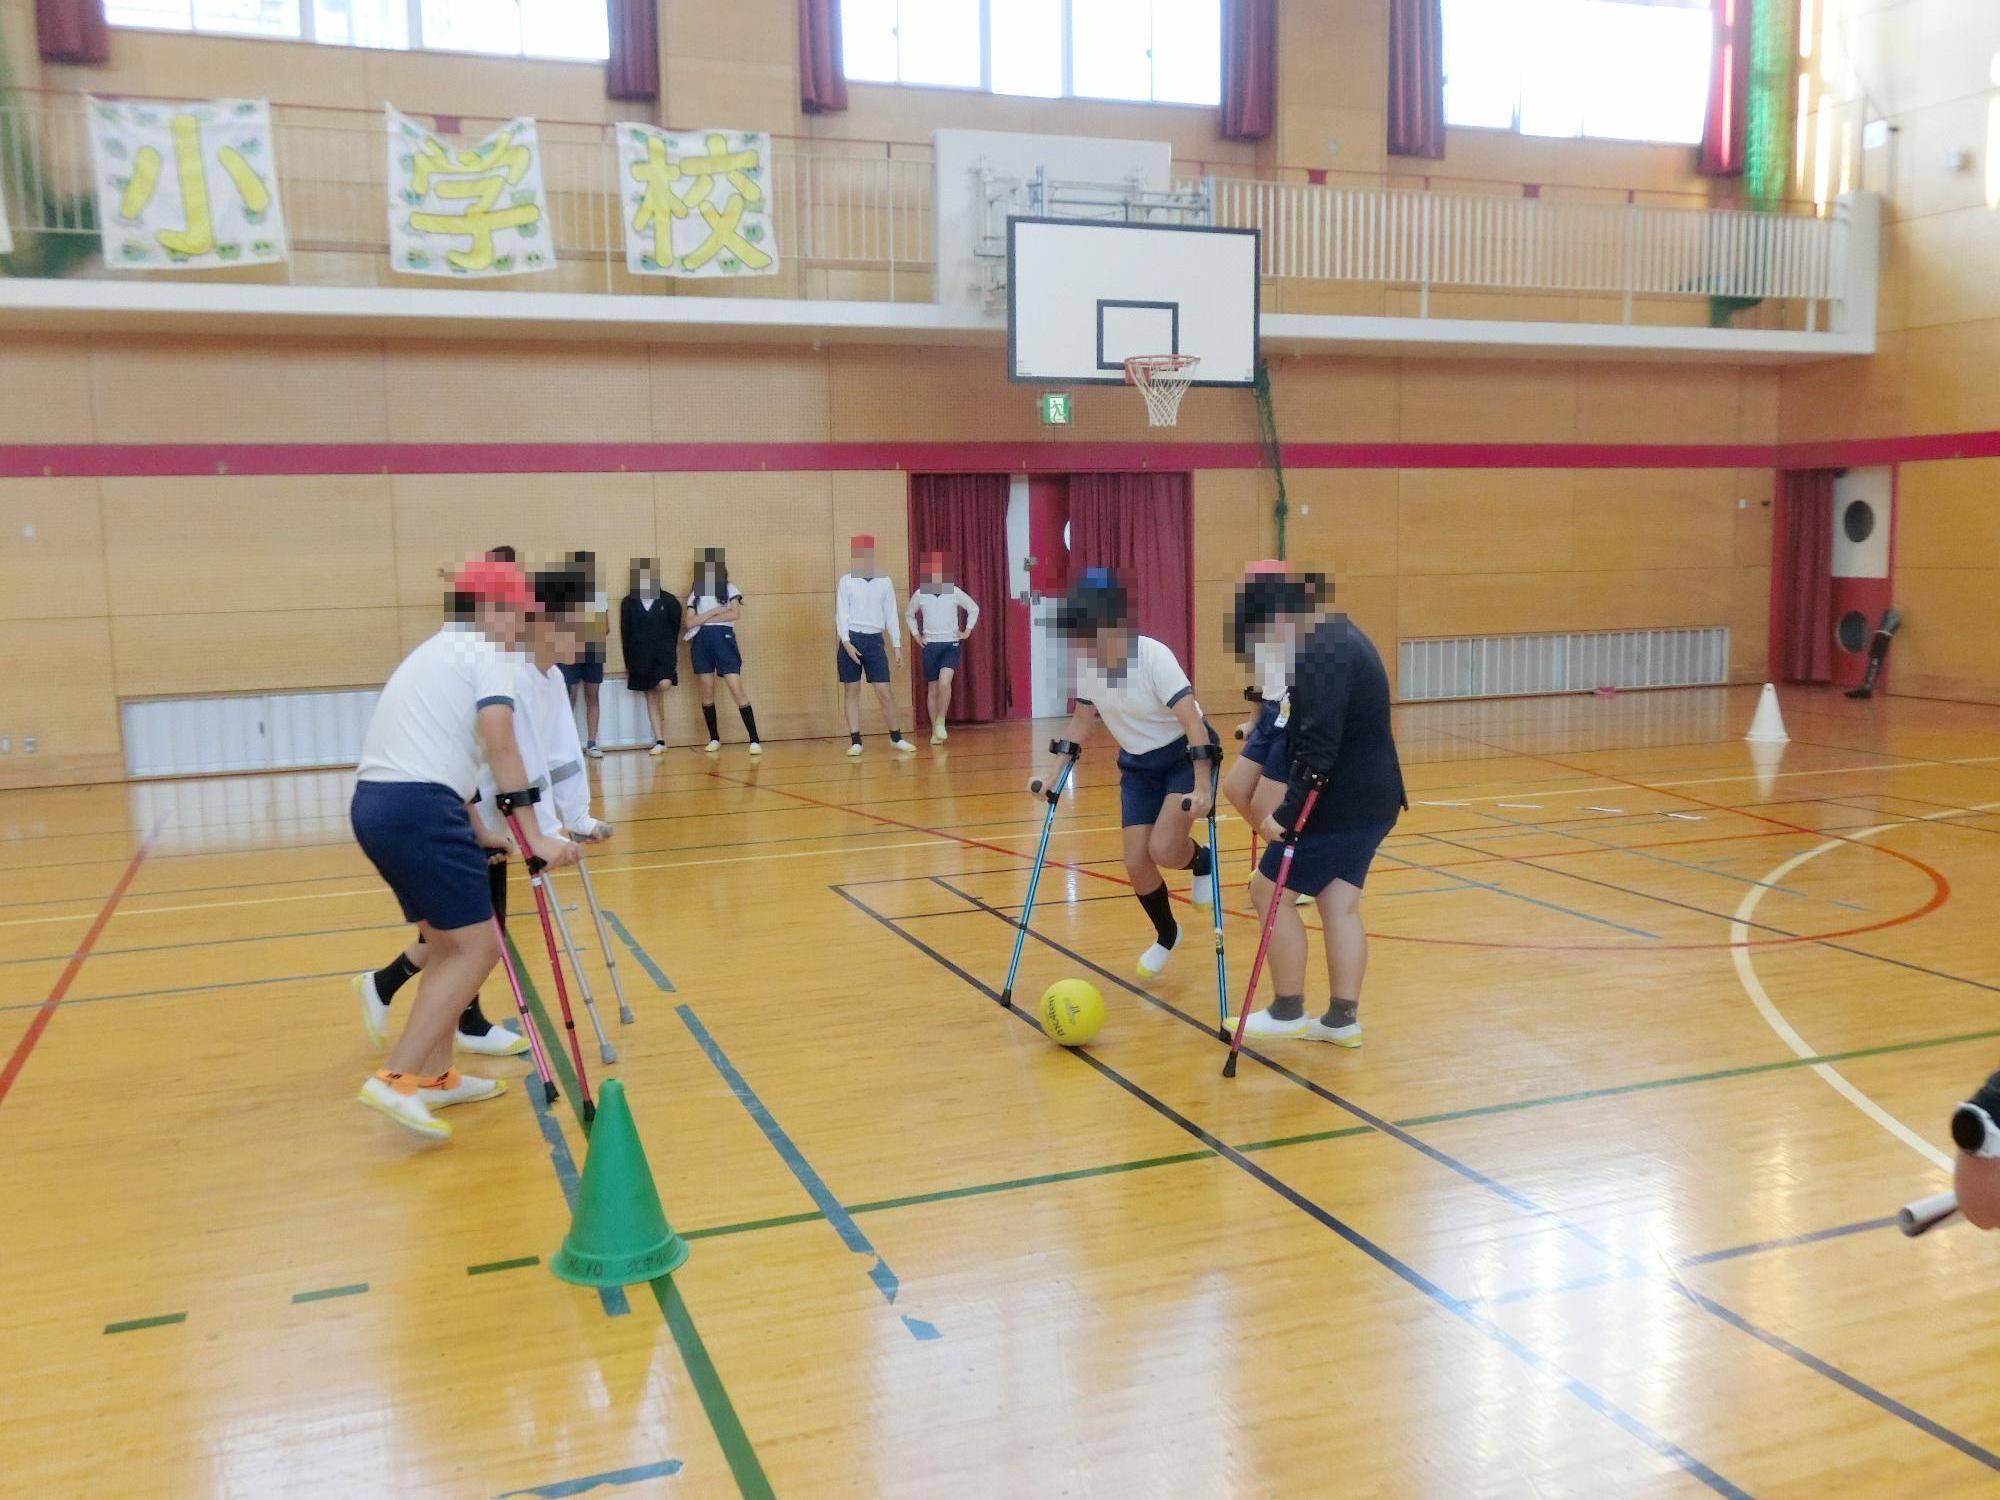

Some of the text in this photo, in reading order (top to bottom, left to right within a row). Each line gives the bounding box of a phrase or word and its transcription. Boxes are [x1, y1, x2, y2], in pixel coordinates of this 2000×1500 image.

[121, 114, 270, 254] 小
[409, 131, 541, 271] 学
[631, 133, 772, 270] 校
